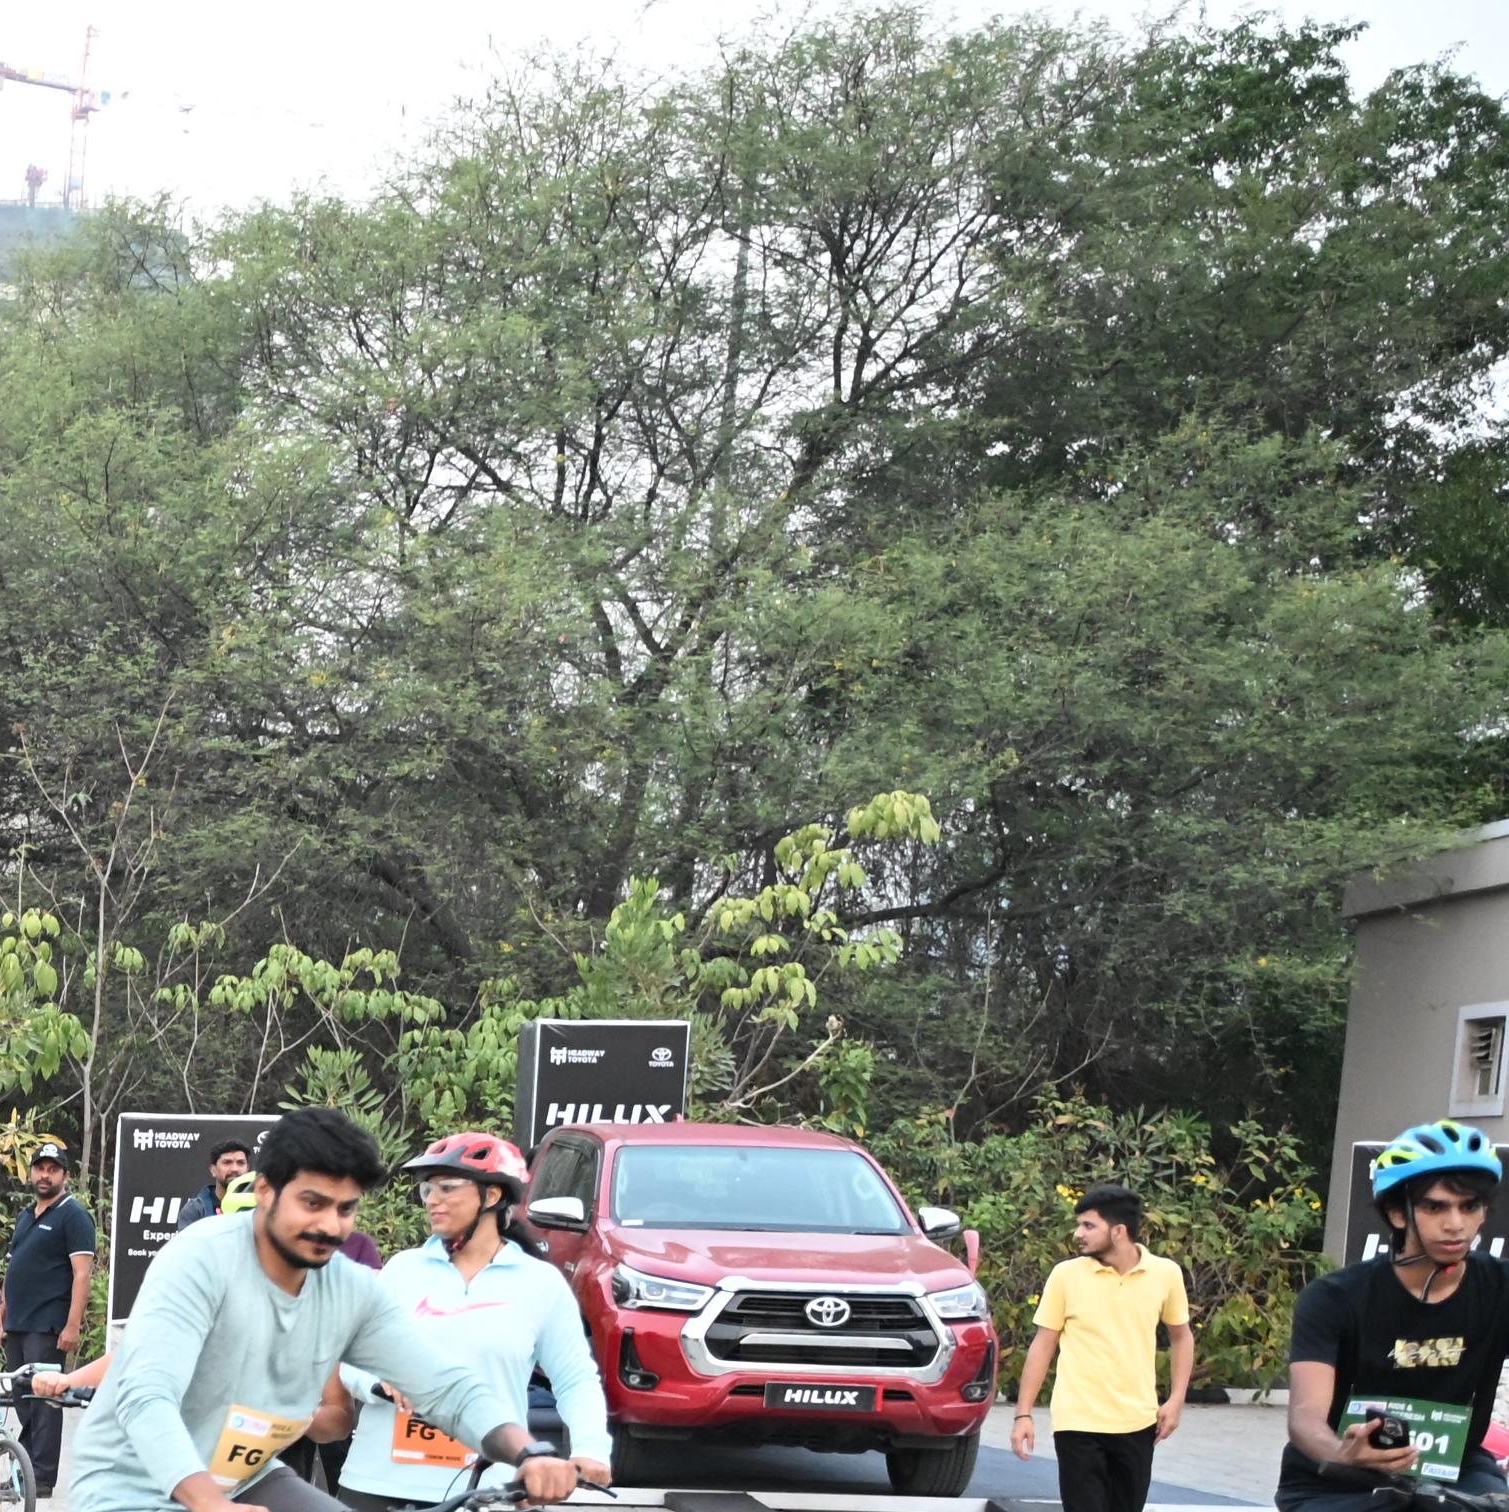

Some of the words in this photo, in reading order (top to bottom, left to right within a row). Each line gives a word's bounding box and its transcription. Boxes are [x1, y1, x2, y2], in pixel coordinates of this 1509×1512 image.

[567, 1049, 605, 1057] HEADWAY
[545, 1103, 671, 1126] HILUX
[154, 1132, 200, 1141] HEADWAY
[154, 1140, 191, 1149] TOYOTA
[128, 1249, 147, 1257] Book
[784, 1389, 859, 1405] HILUX
[405, 1422, 436, 1441] FG
[227, 1444, 263, 1466] FG
